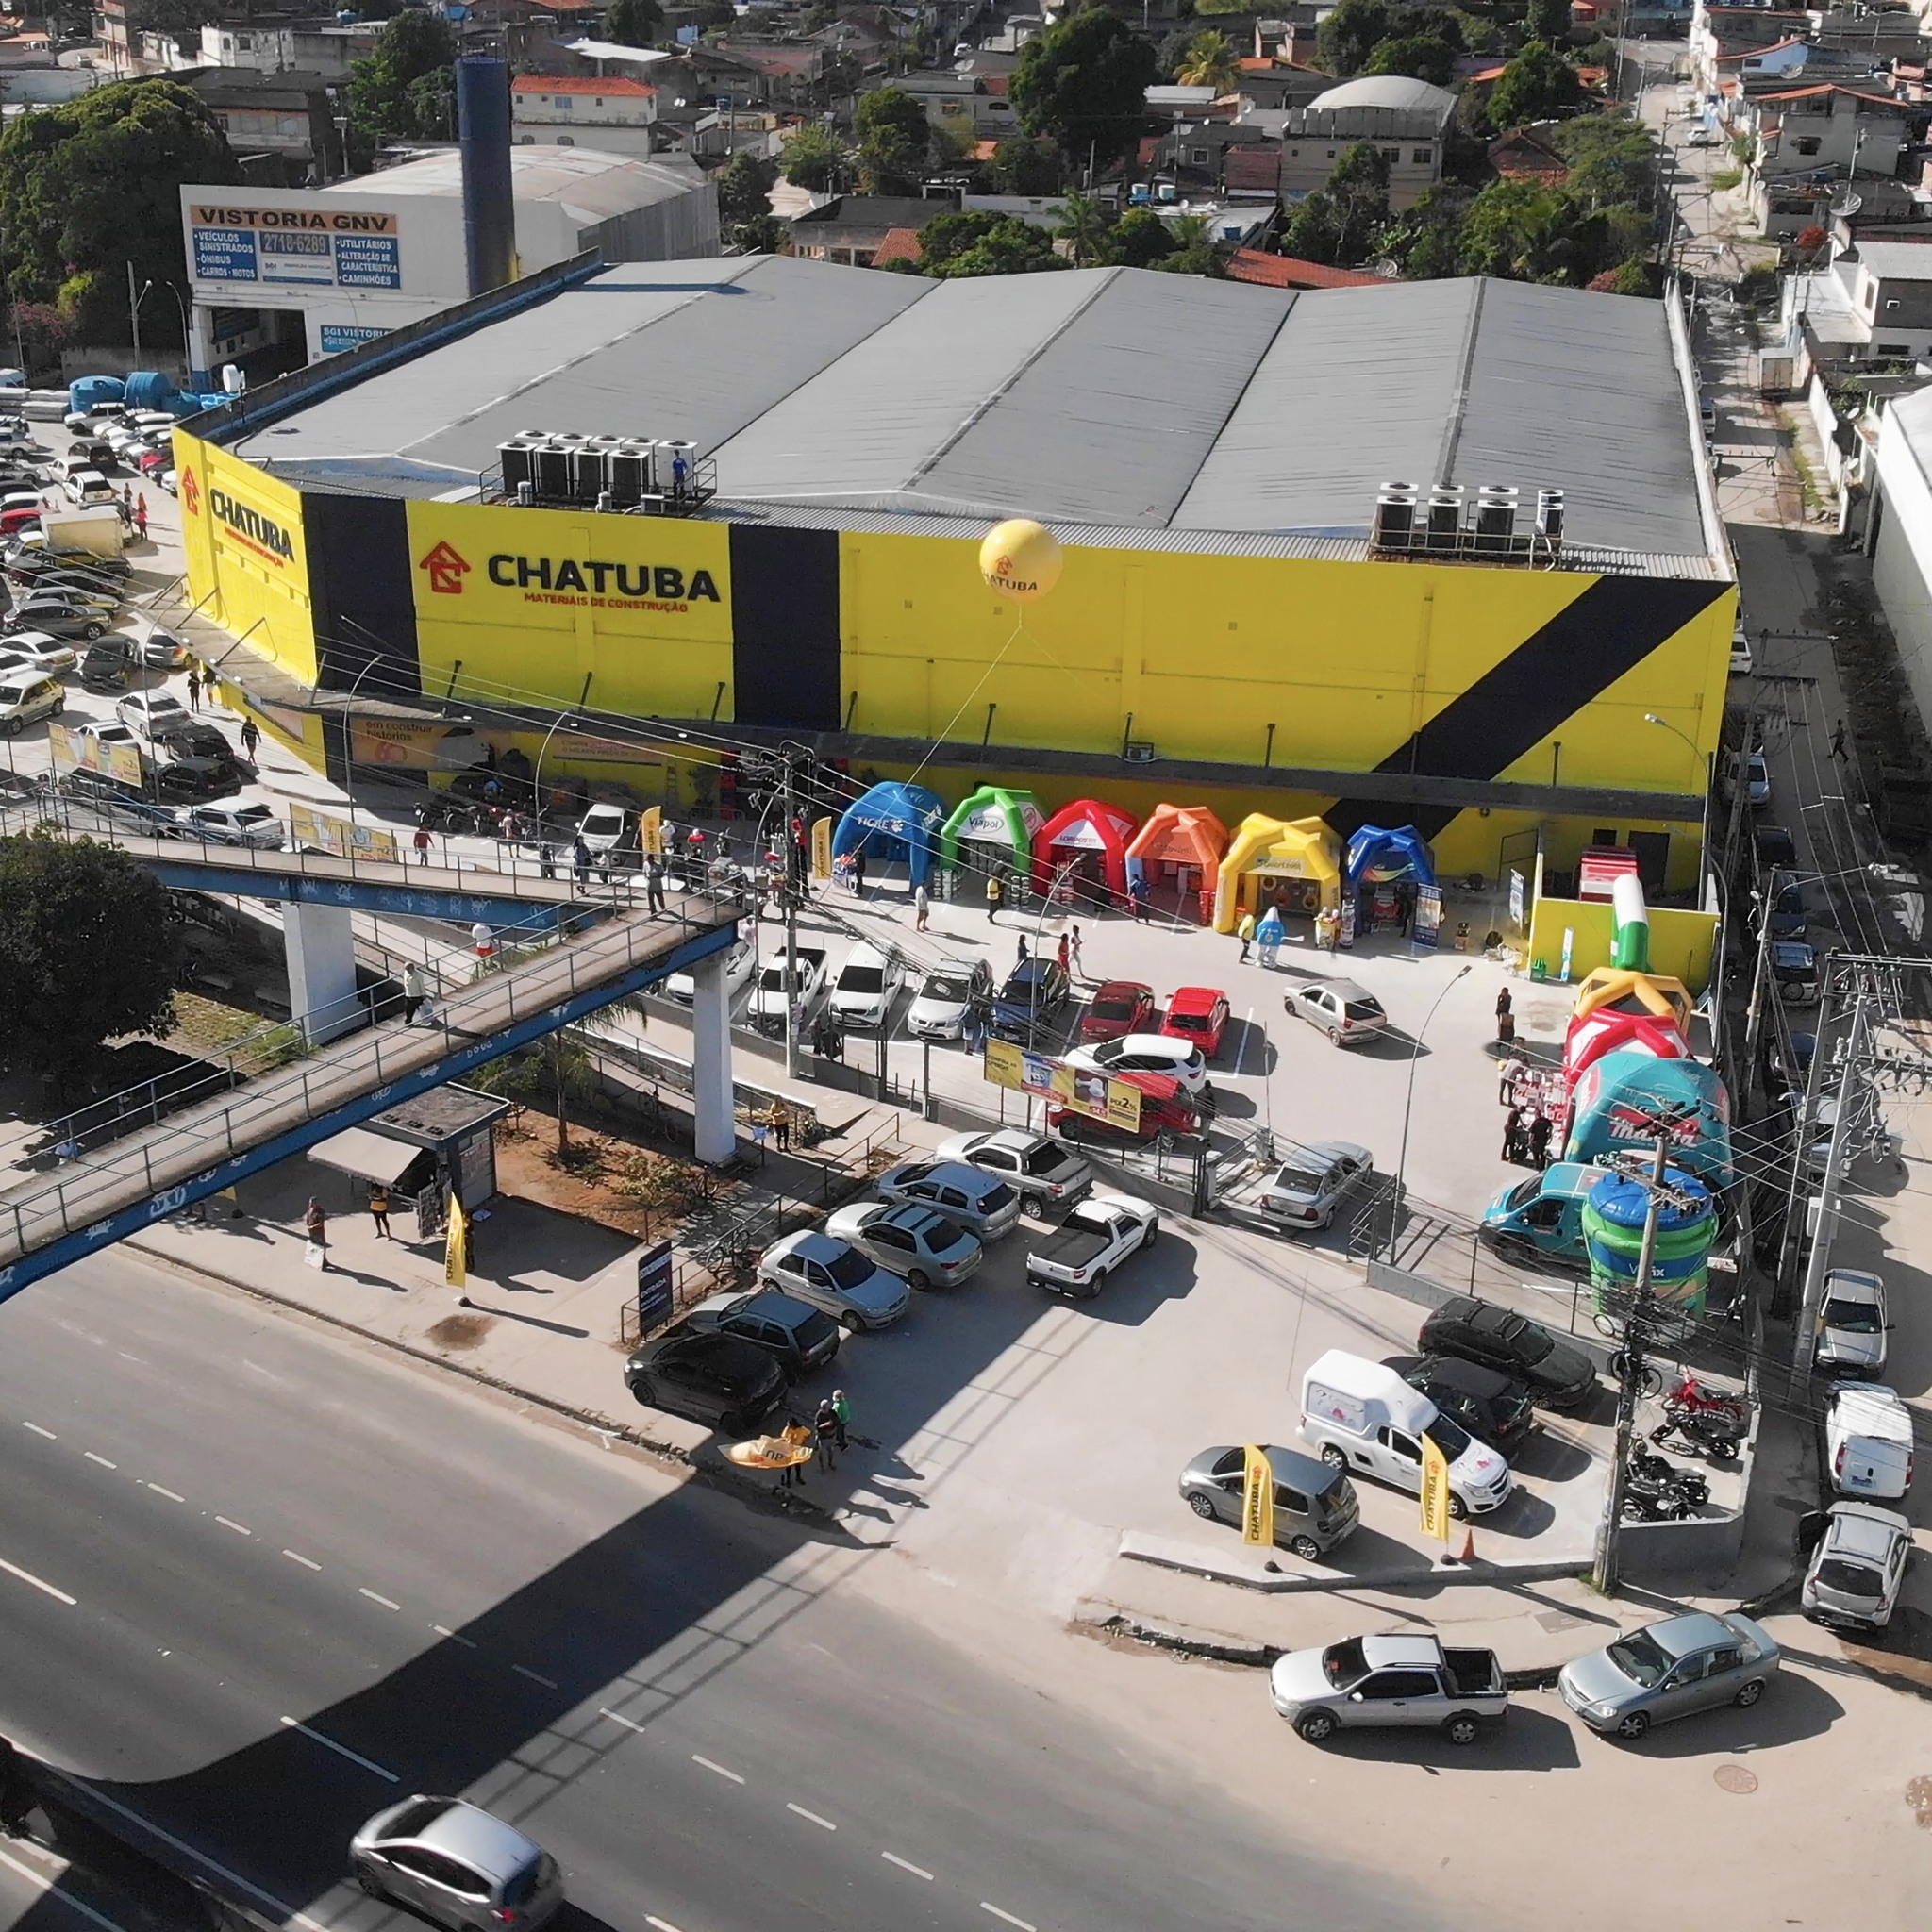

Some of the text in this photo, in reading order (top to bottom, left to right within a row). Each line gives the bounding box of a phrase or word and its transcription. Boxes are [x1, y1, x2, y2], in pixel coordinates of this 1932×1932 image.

[199, 208, 389, 231] VISTORIA GNV
[198, 231, 240, 242] VEÍCULOS
[199, 242, 254, 254] SINISTRADOS
[340, 239, 391, 251] UTILITÁRIOS
[200, 253, 232, 264] ÔNIBUS
[341, 251, 380, 262] ALTERAÇÃO
[342, 274, 391, 286] CAMINHÕES
[323, 326, 341, 336] SGI
[209, 488, 295, 564] CHATUBA
[487, 554, 722, 603] CHATUBA
[524, 592, 689, 614] MATERIAIS DE CONSTRUÇÃO
[366, 721, 432, 734] em construir
[857, 815, 890, 830] TIGRE
[969, 815, 1000, 829] Viapol
[1426, 1475, 1438, 1532] CHATUBA
[1250, 1482, 1261, 1541] CHATUBA
